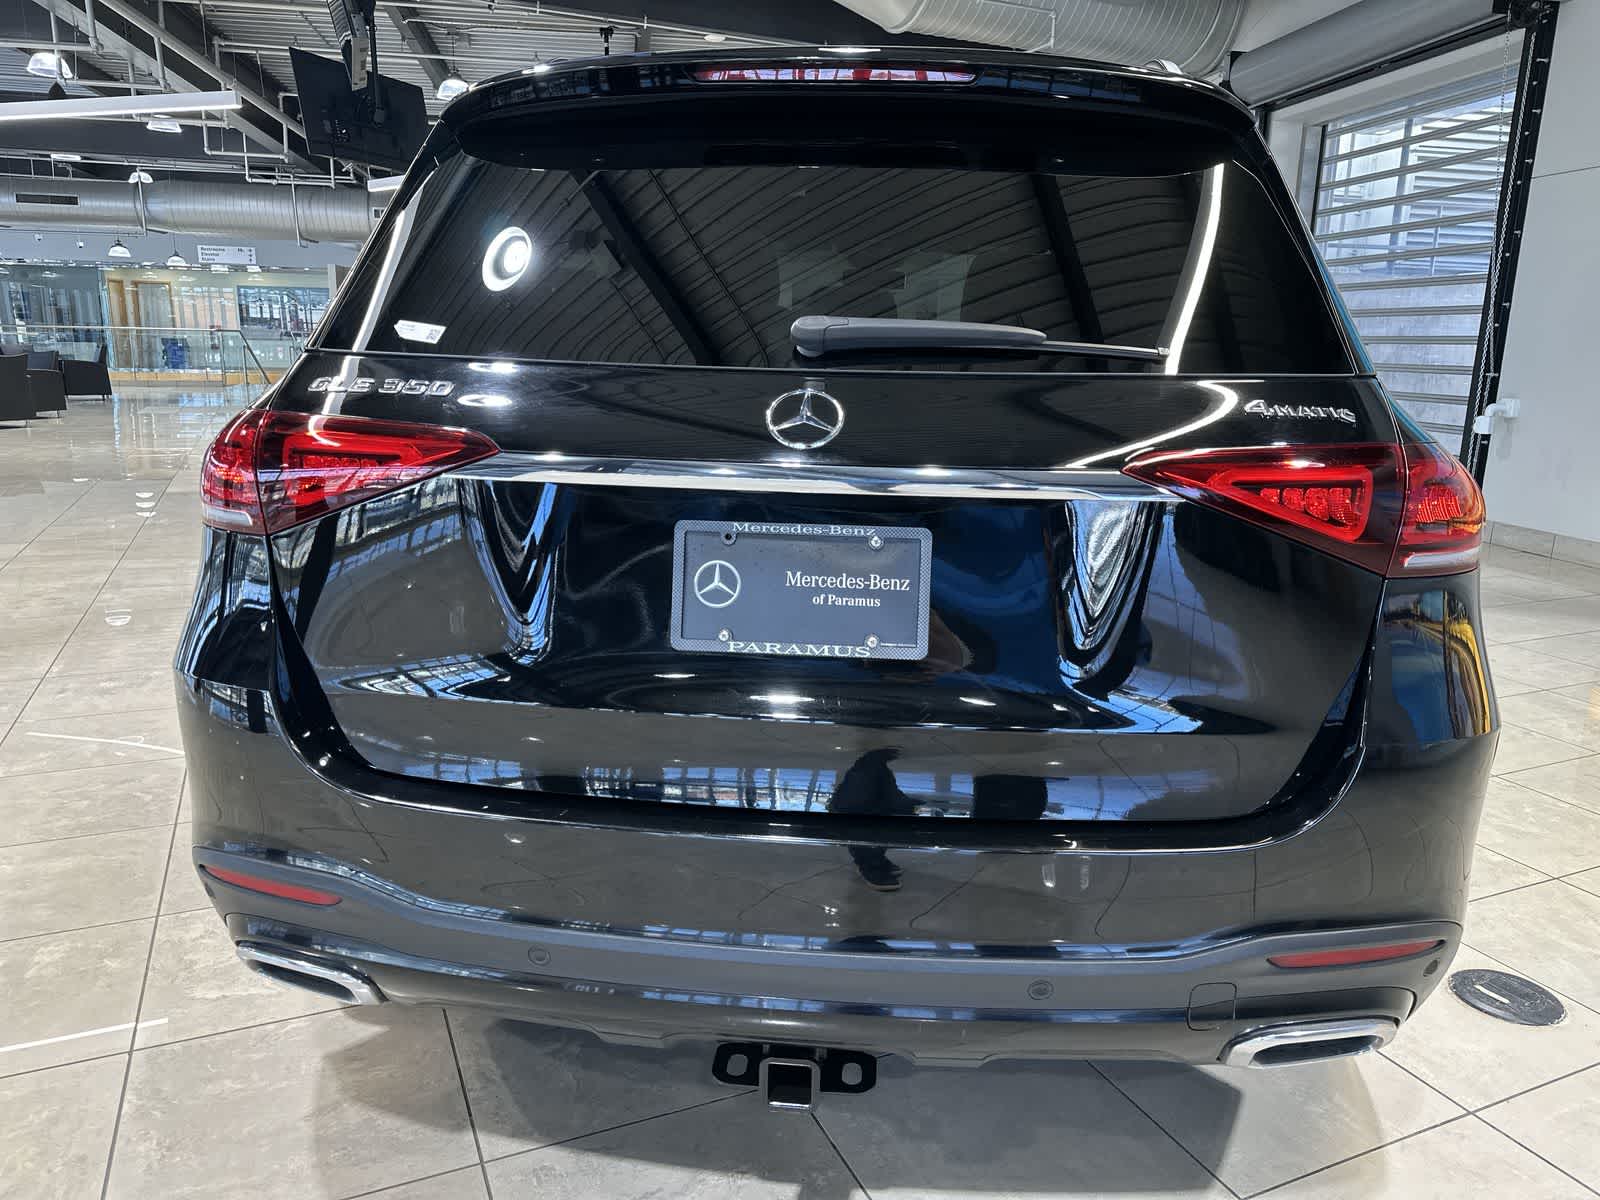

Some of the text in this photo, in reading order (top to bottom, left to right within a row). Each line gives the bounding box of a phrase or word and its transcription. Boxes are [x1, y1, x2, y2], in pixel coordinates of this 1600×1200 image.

[308, 376, 455, 397] GLE 350
[1244, 399, 1356, 423] 4MATIC
[732, 522, 877, 537] Mercedes-Benz
[785, 570, 910, 591] Mercedes-Benz
[812, 594, 881, 608] of Paramus
[727, 640, 871, 658] PARAMUS
